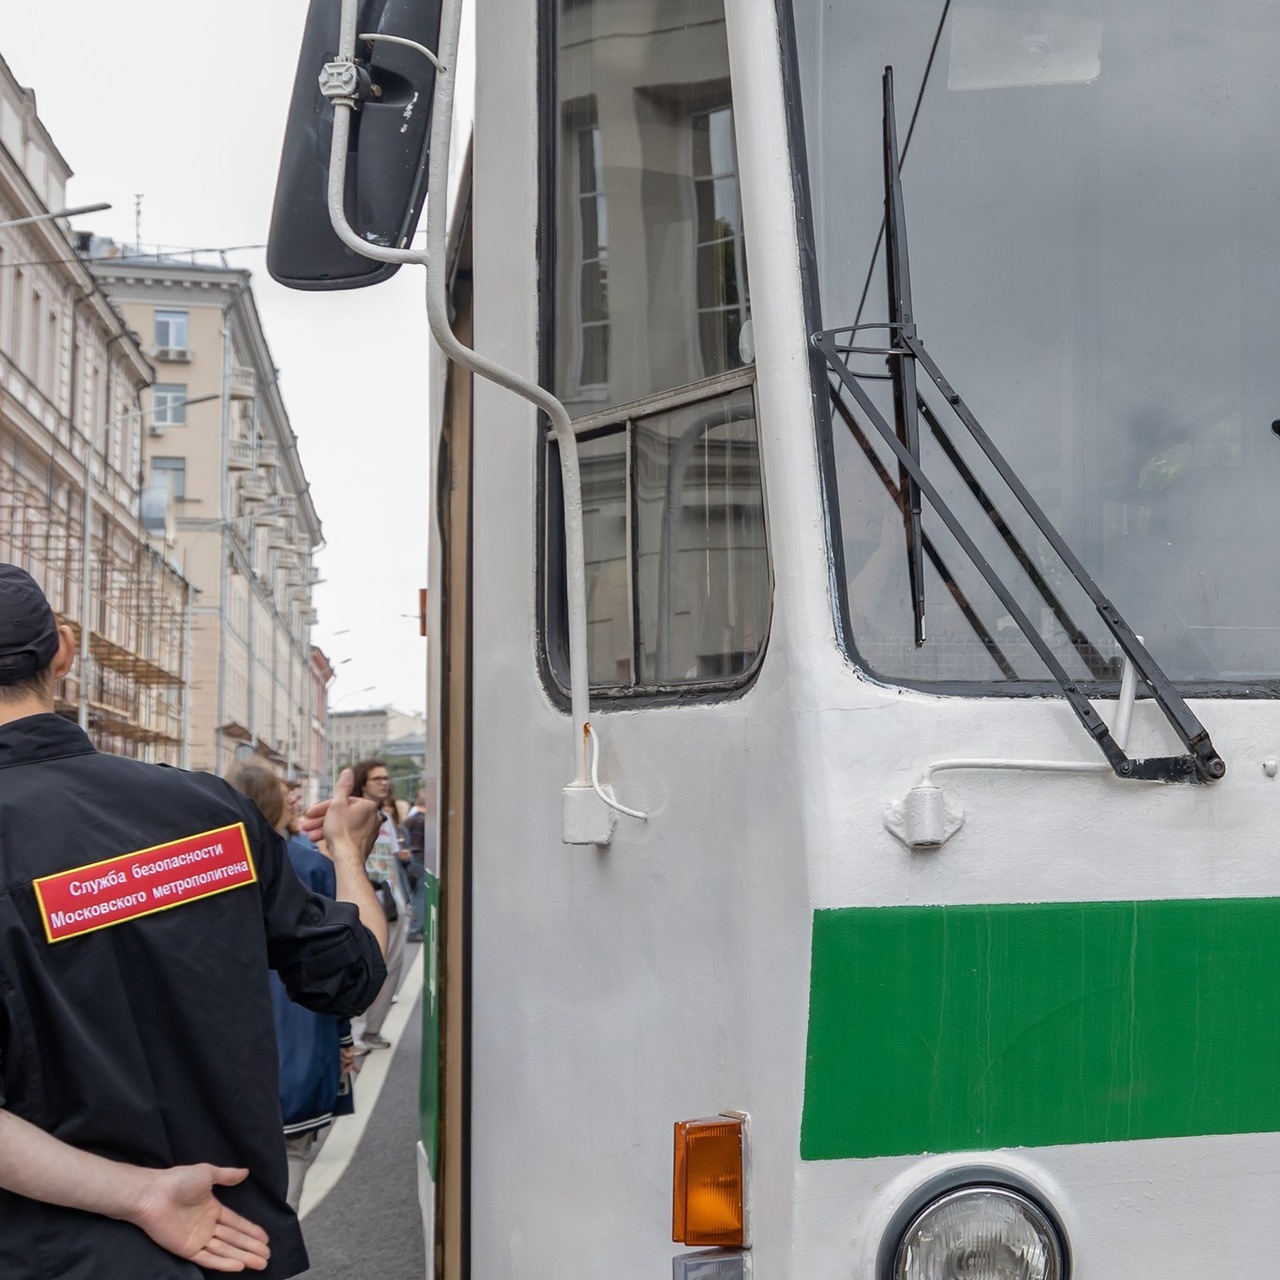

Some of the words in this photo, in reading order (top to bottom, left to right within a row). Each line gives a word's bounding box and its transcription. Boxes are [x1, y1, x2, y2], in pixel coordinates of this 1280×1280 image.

[50, 890, 147, 929] Московского
[152, 860, 249, 900] метрополитена
[69, 868, 127, 897] Служба
[131, 842, 223, 879] безопасности
